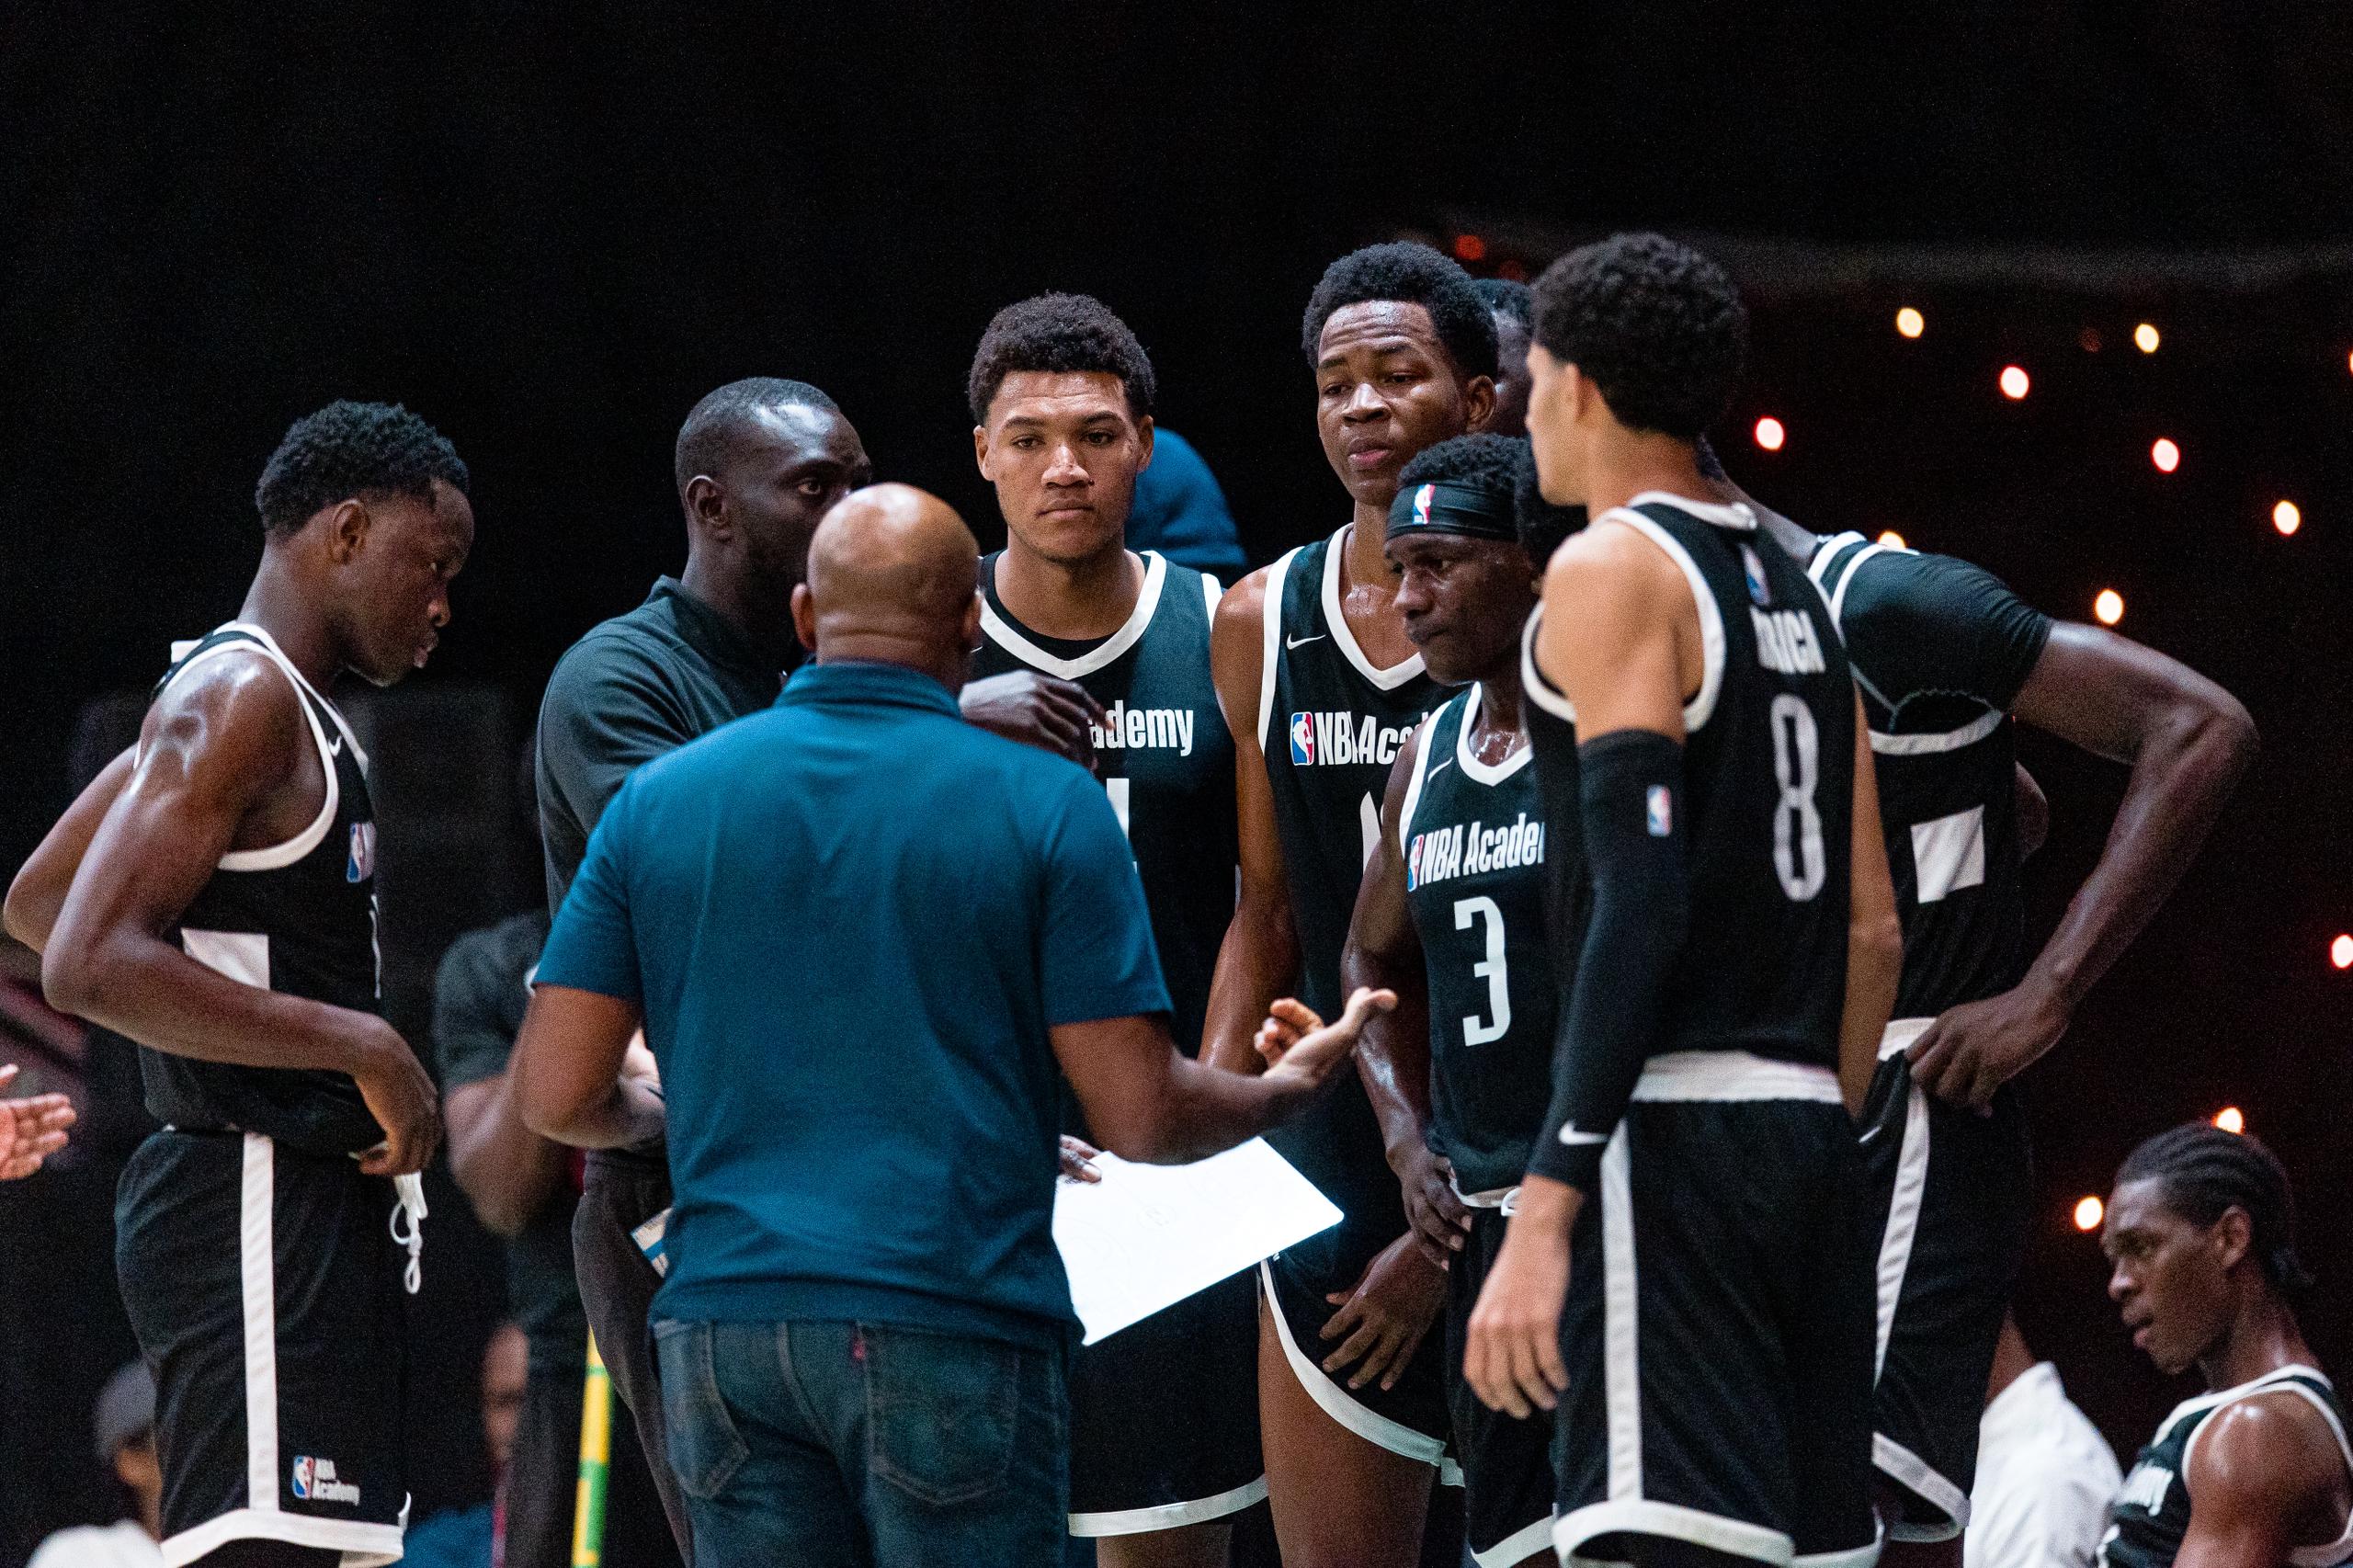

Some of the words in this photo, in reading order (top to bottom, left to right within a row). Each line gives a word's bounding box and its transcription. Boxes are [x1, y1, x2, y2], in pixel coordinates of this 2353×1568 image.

[1088, 699, 1194, 757] ademy
[1418, 824, 1463, 886] NBA
[1462, 812, 1544, 876] Acade
[1770, 693, 1826, 902] 8
[1453, 895, 1511, 1047] 3
